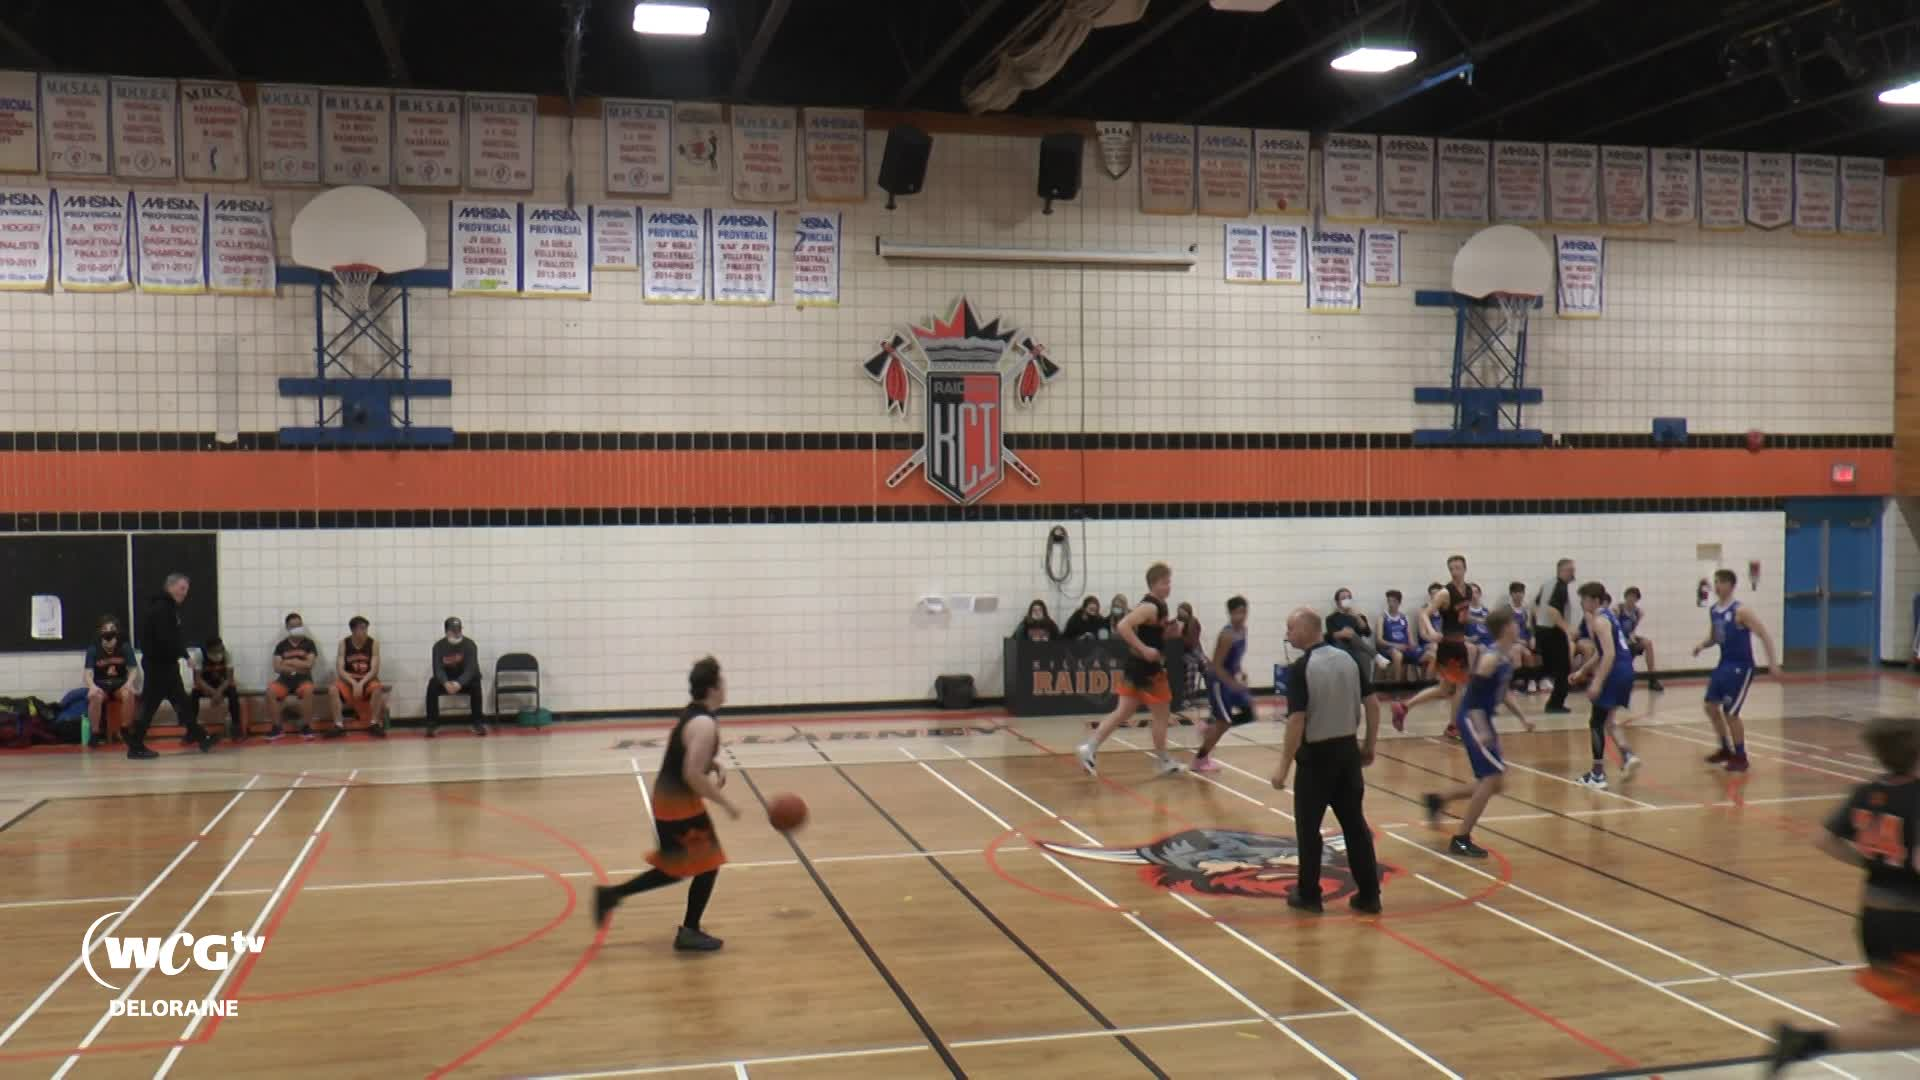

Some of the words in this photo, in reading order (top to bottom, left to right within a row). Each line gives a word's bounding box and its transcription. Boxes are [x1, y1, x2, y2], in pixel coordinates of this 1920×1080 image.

[648, 212, 698, 225] MHSAA
[718, 215, 769, 227] MHSAA
[457, 222, 512, 233] PROVINCIAL
[529, 224, 582, 235] PROVINCIAL
[648, 228, 698, 239] PROVINCIAL
[718, 230, 768, 240] PROVINCIAL
[463, 246, 507, 255] VOLLEYBALL
[534, 249, 578, 258] VOLLEYBALL
[652, 251, 694, 260] VOLLEYBALL
[463, 257, 507, 265] CHAMPIONS
[933, 402, 997, 494] KCI
